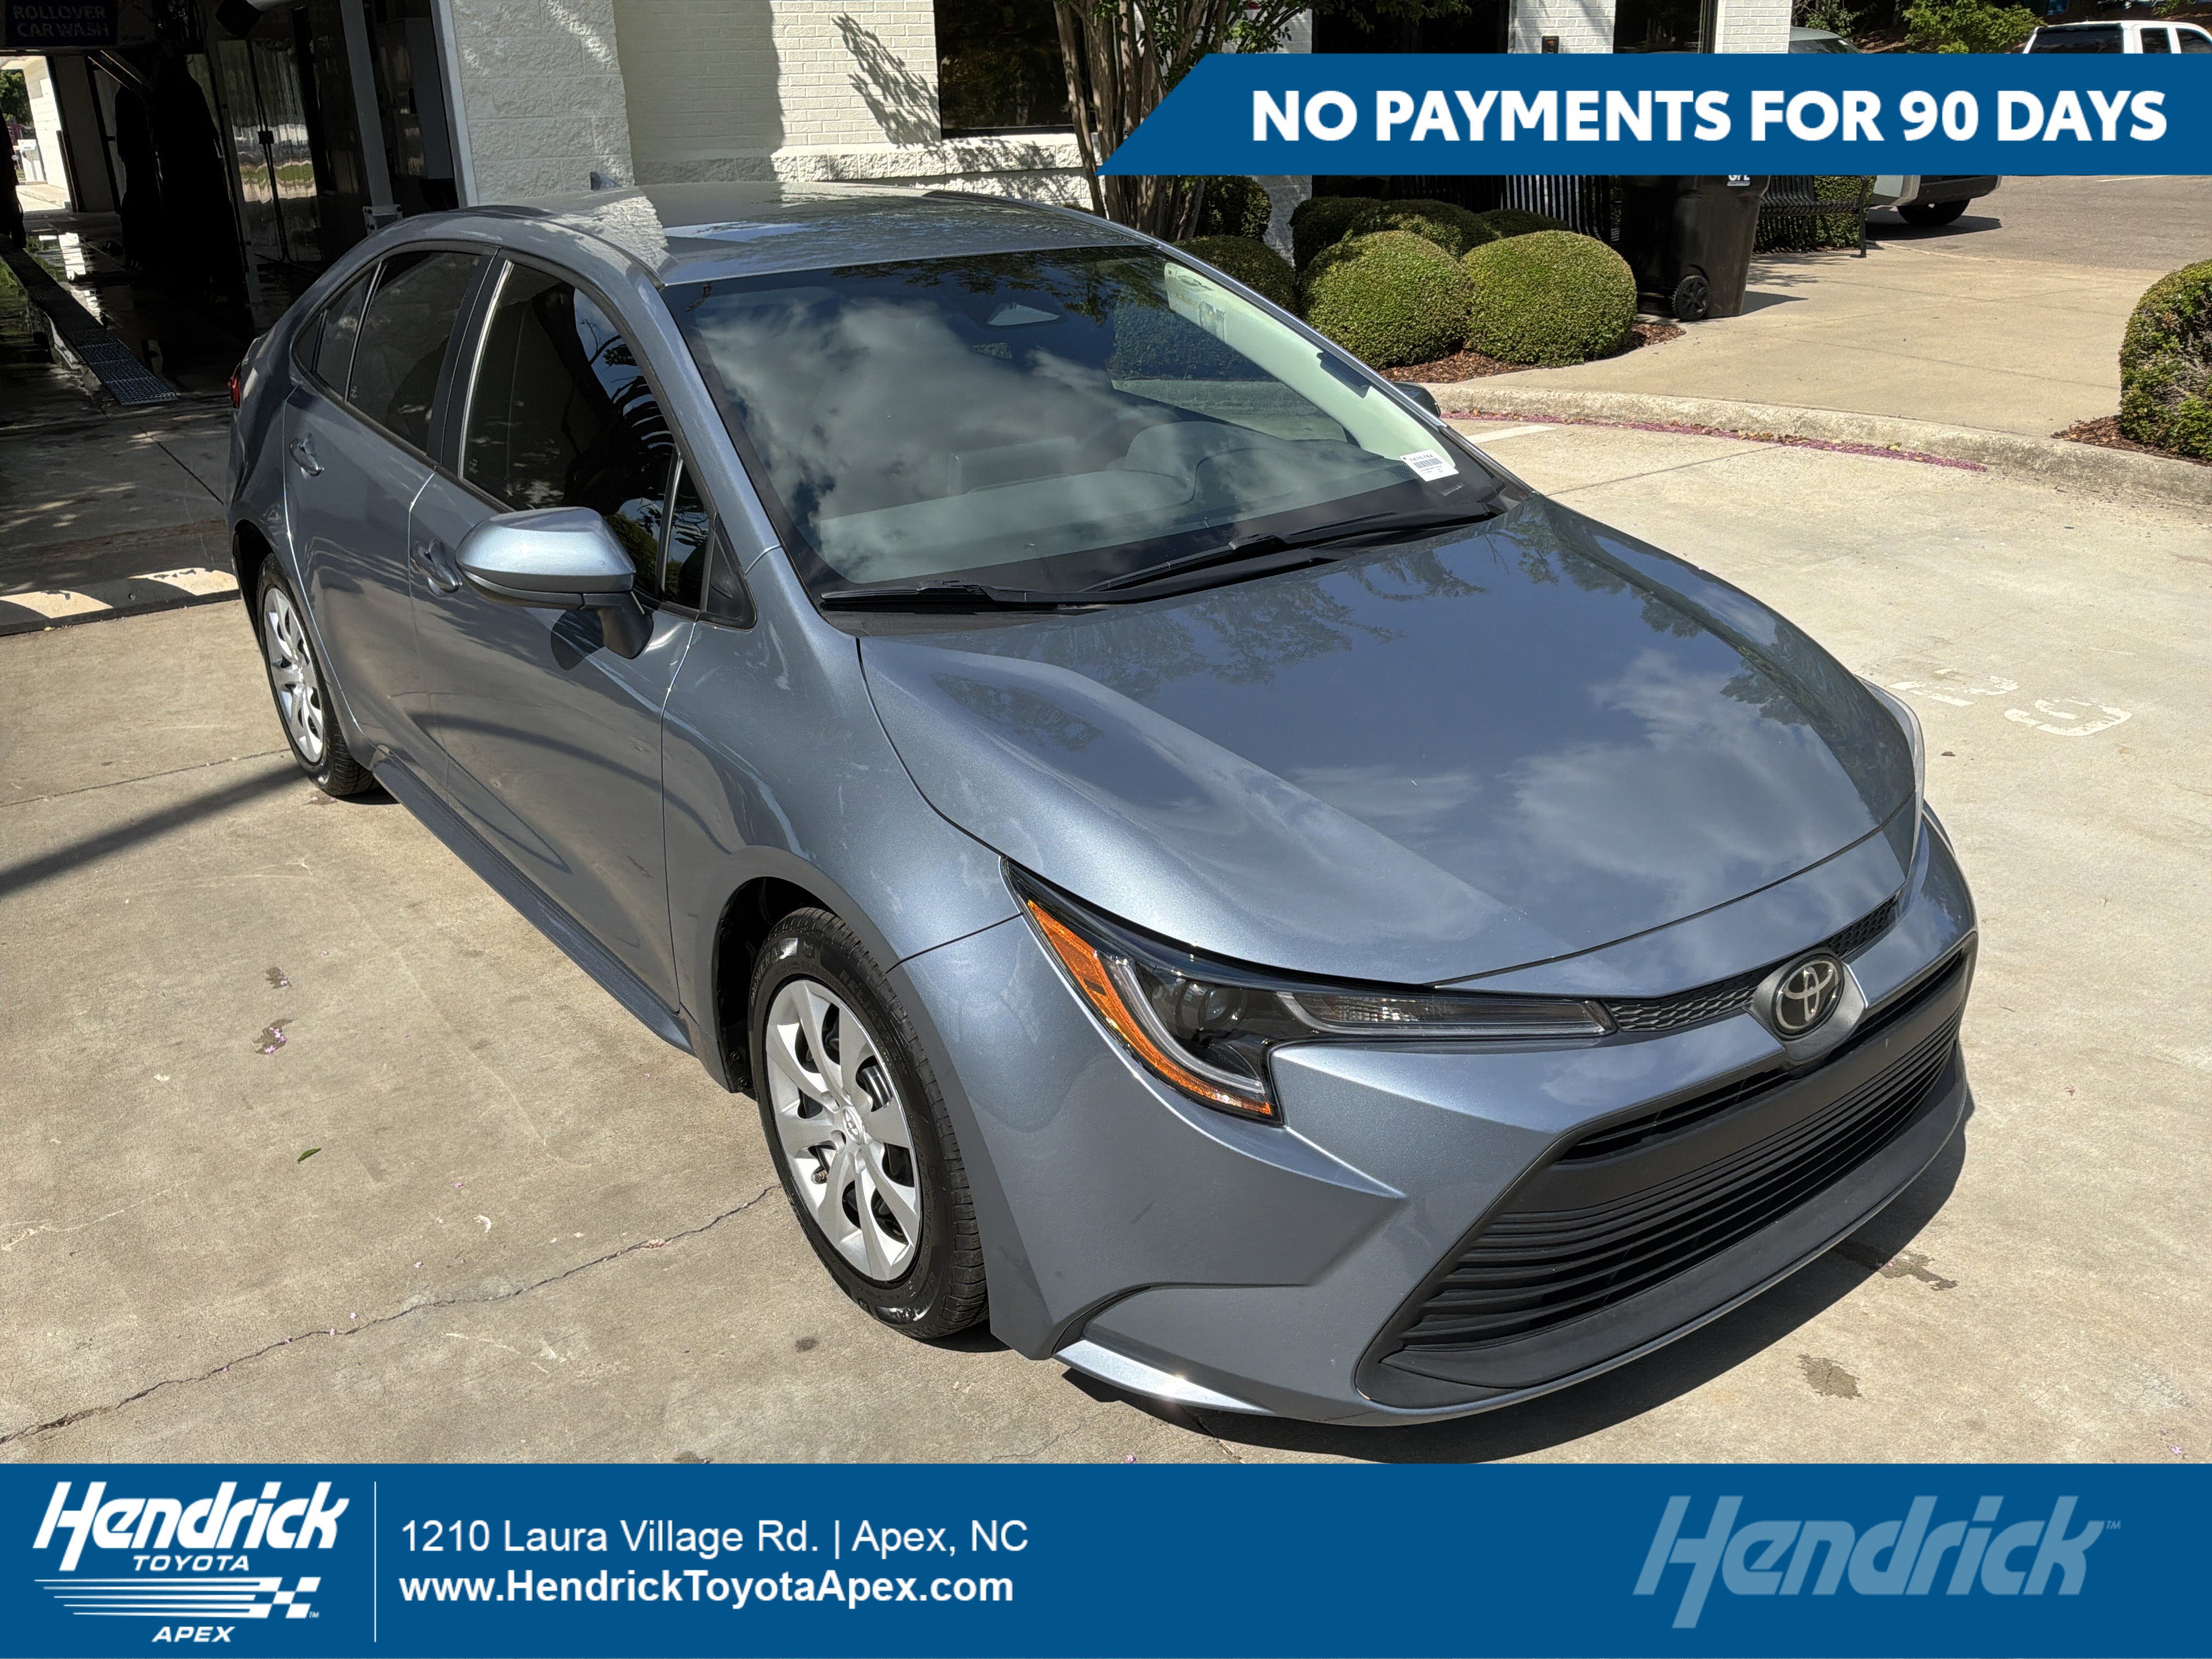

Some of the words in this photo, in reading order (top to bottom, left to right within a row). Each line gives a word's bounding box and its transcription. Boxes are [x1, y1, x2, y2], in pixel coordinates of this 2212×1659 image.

[13, 4, 106, 19] ROLLOVER
[16, 22, 54, 37] CAR
[55, 22, 110, 37] WASH
